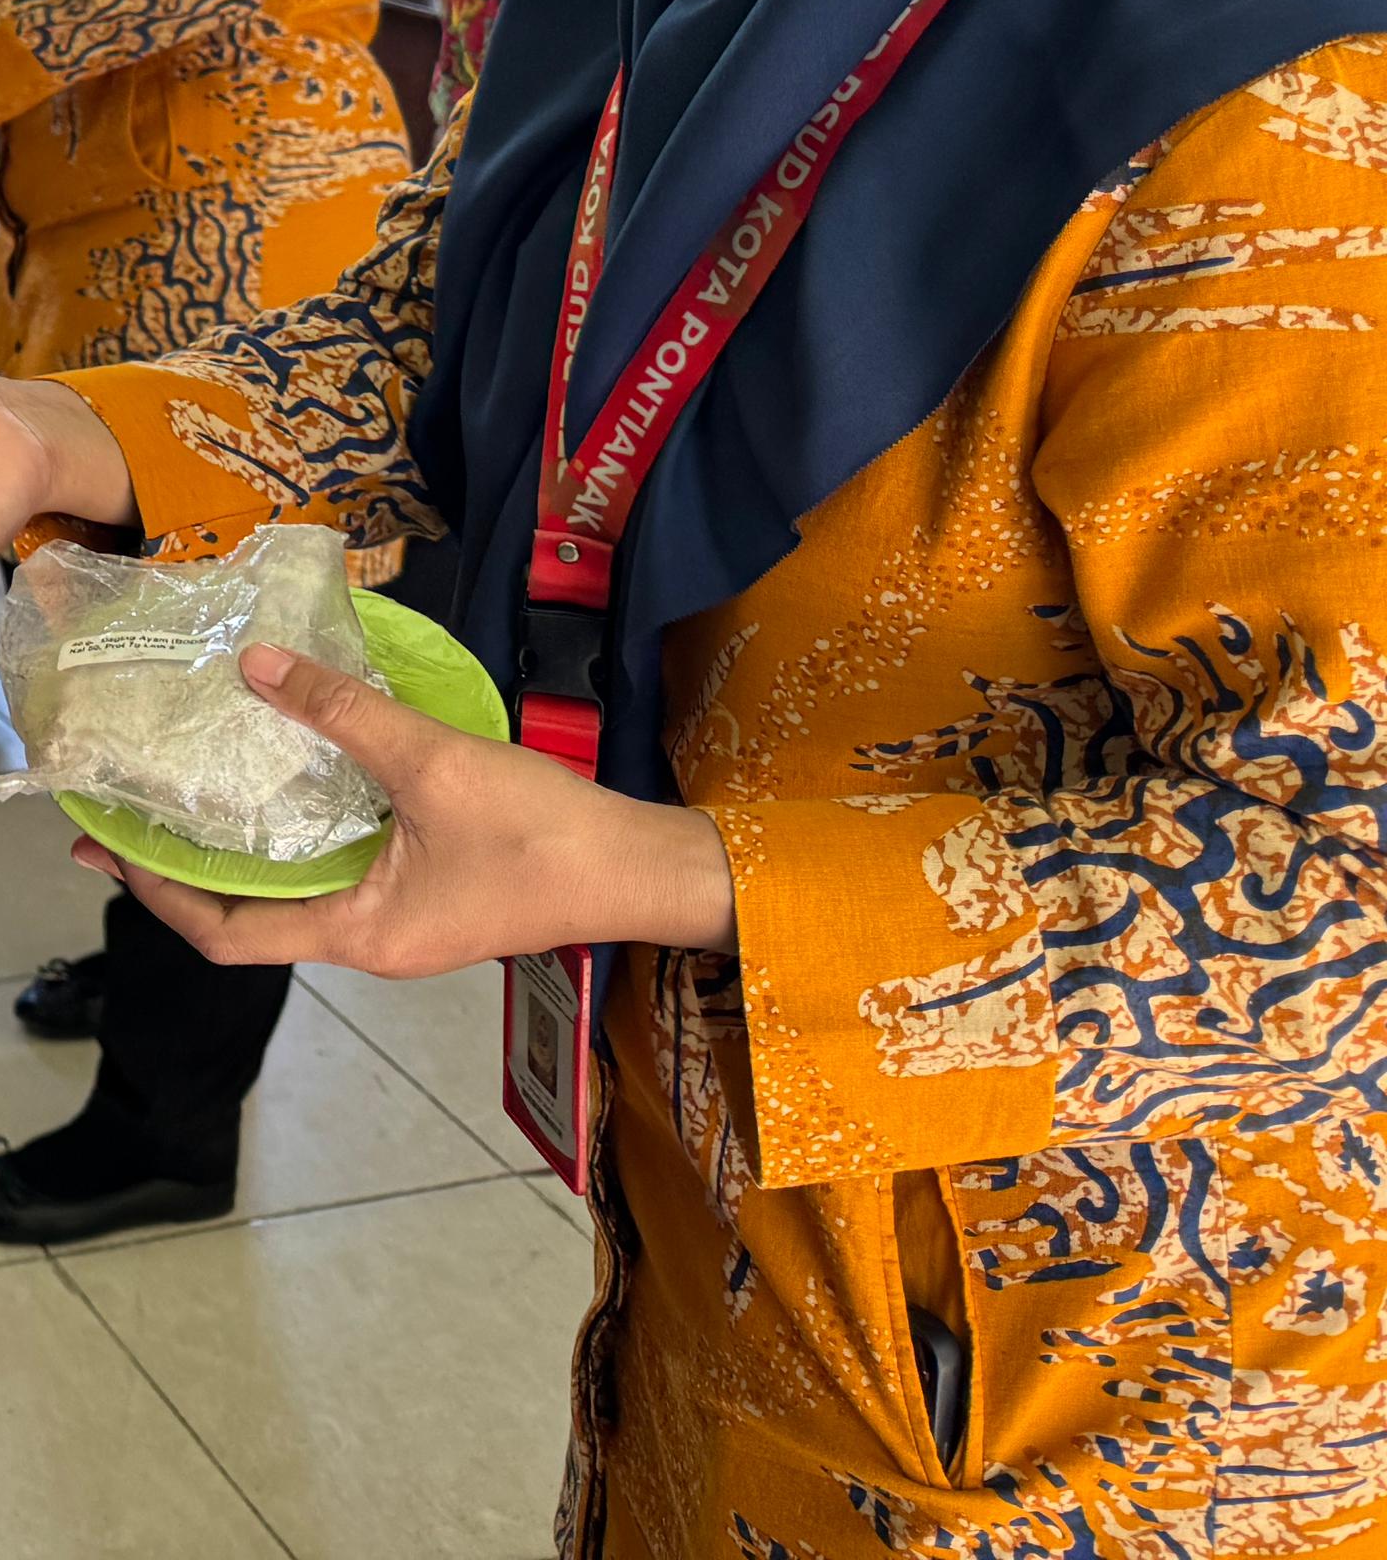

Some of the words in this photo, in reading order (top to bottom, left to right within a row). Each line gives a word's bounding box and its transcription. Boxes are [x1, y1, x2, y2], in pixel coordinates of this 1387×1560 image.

[577, 130, 615, 245] KOTA
[696, 192, 783, 305] KOTA
[565, 310, 710, 532] PONTIANAK
[139, 635, 168, 644] Ayam
